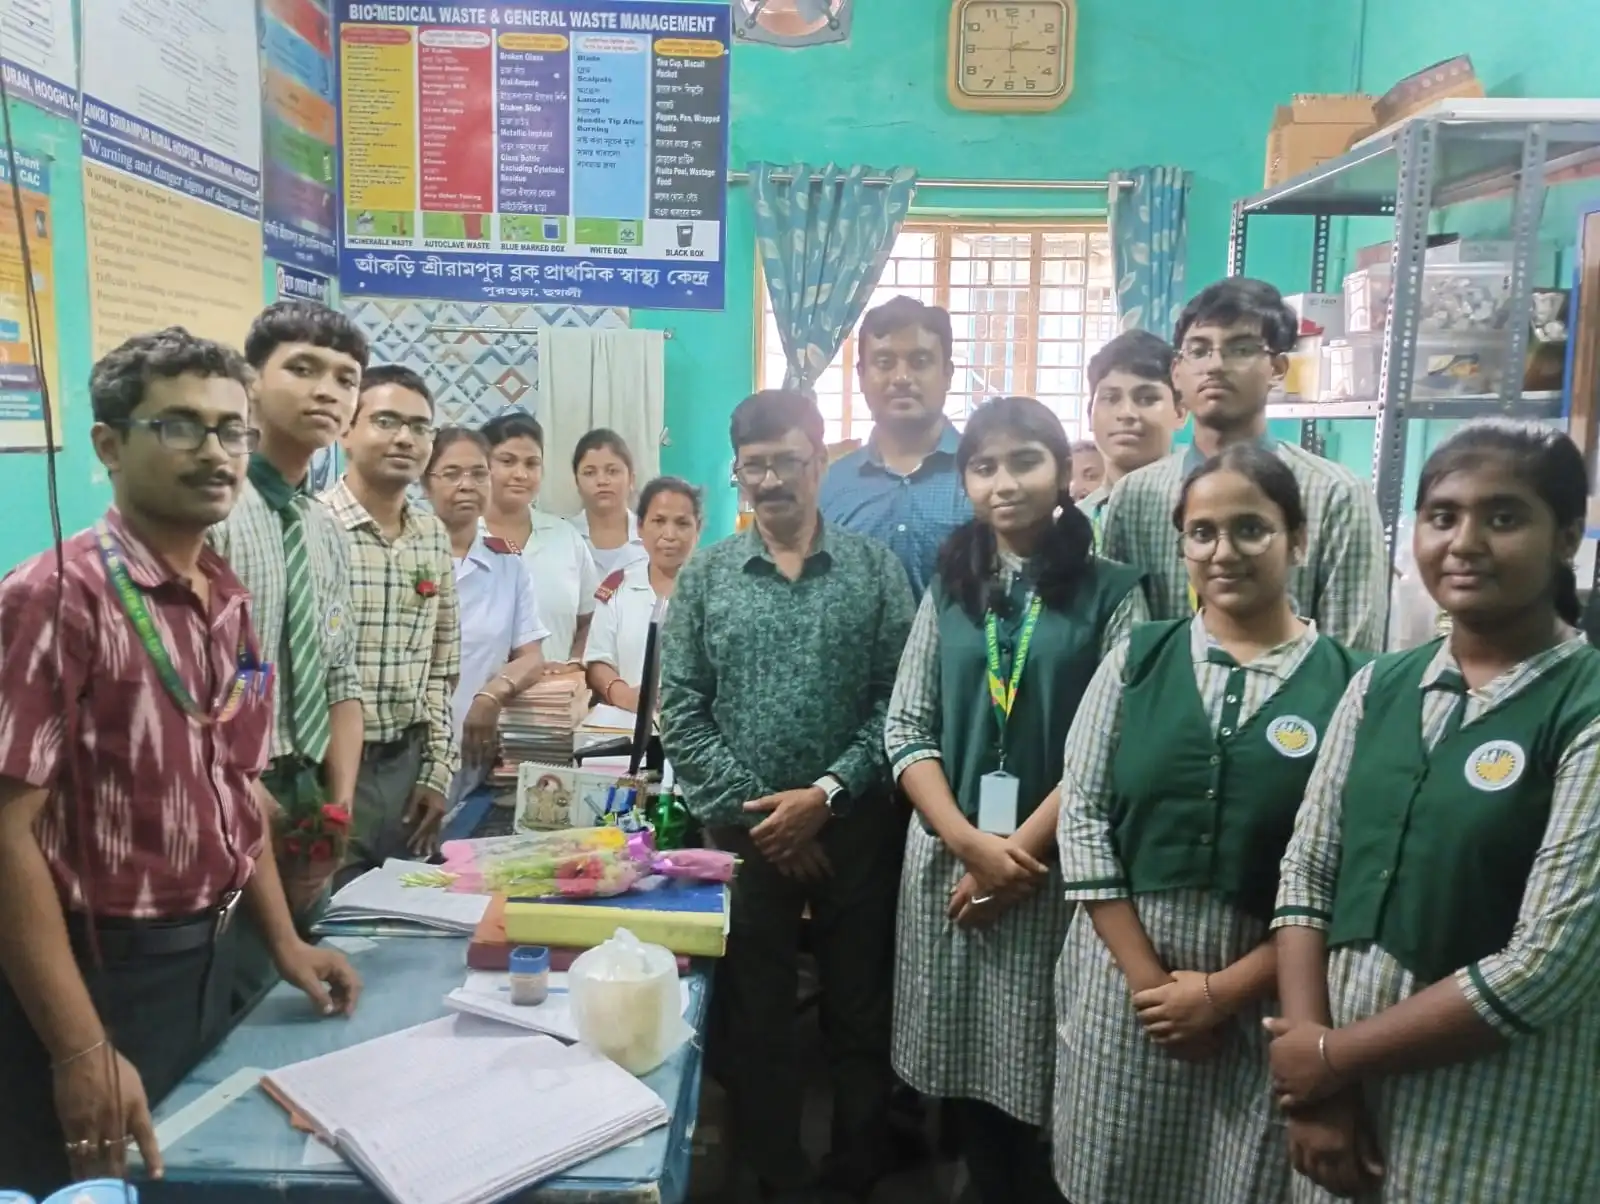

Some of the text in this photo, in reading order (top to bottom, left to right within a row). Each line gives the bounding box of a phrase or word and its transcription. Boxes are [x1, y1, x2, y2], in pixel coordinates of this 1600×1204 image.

[349, 4, 716, 32] BIO-MEDICAL WASTE & GENERAL WASTE MANAGEMENT
[1044, 23, 1055, 33] 2
[1046, 45, 1057, 55] 3
[966, 65, 977, 75] 8
[1041, 67, 1052, 76] 4
[982, 78, 994, 88] 7
[1004, 81, 1015, 90] 6
[1025, 80, 1036, 89] 5
[34, 78, 75, 110] HOOGHLY
[608, 118, 621, 126] Tip
[89, 136, 133, 170] Warning
[134, 159, 152, 174] and
[154, 164, 182, 187] danger
[424, 240, 490, 250] AUTOCLAVE WASTE
[500, 243, 520, 251] BLUE
[521, 244, 549, 252] MARKED
[590, 246, 628, 255] WHITE BOX
[666, 249, 704, 257] BLACK BOX
[353, 253, 416, 278] আঁকড়ি
[419, 255, 504, 283] শ্রীরামপুর
[544, 260, 615, 283] প্রাথমিক
[667, 269, 710, 287] কেন্দ্র
